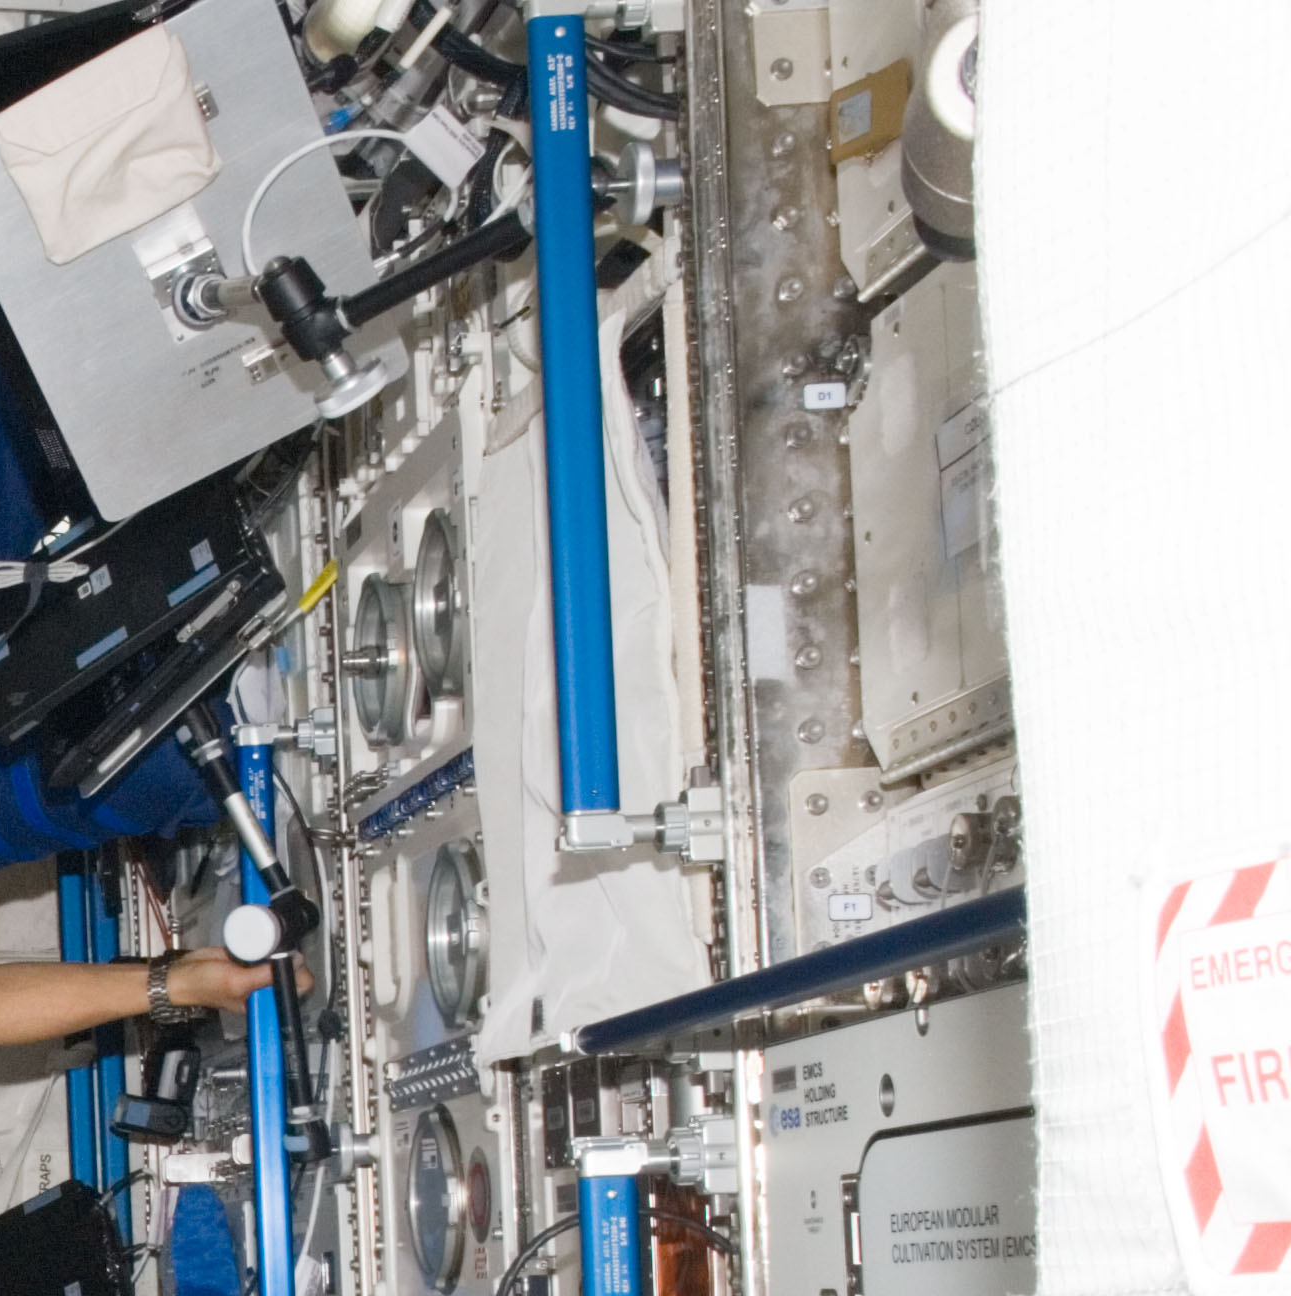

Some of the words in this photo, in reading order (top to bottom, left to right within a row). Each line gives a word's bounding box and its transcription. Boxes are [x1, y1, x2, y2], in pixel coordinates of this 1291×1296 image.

[803, 1062, 823, 1081] EMCS
[1211, 1045, 1291, 1108] FIR
[804, 1083, 836, 1104] HOLDING
[780, 1106, 801, 1129] esa
[805, 1105, 849, 1128] STRUCTURE
[39, 1154, 52, 1194] RAPS
[890, 1210, 944, 1233] EUROPEAN
[947, 1204, 1000, 1229] MODULAR
[892, 1241, 954, 1264] CULTIVATION
[956, 1238, 1000, 1261] SYSTEM
